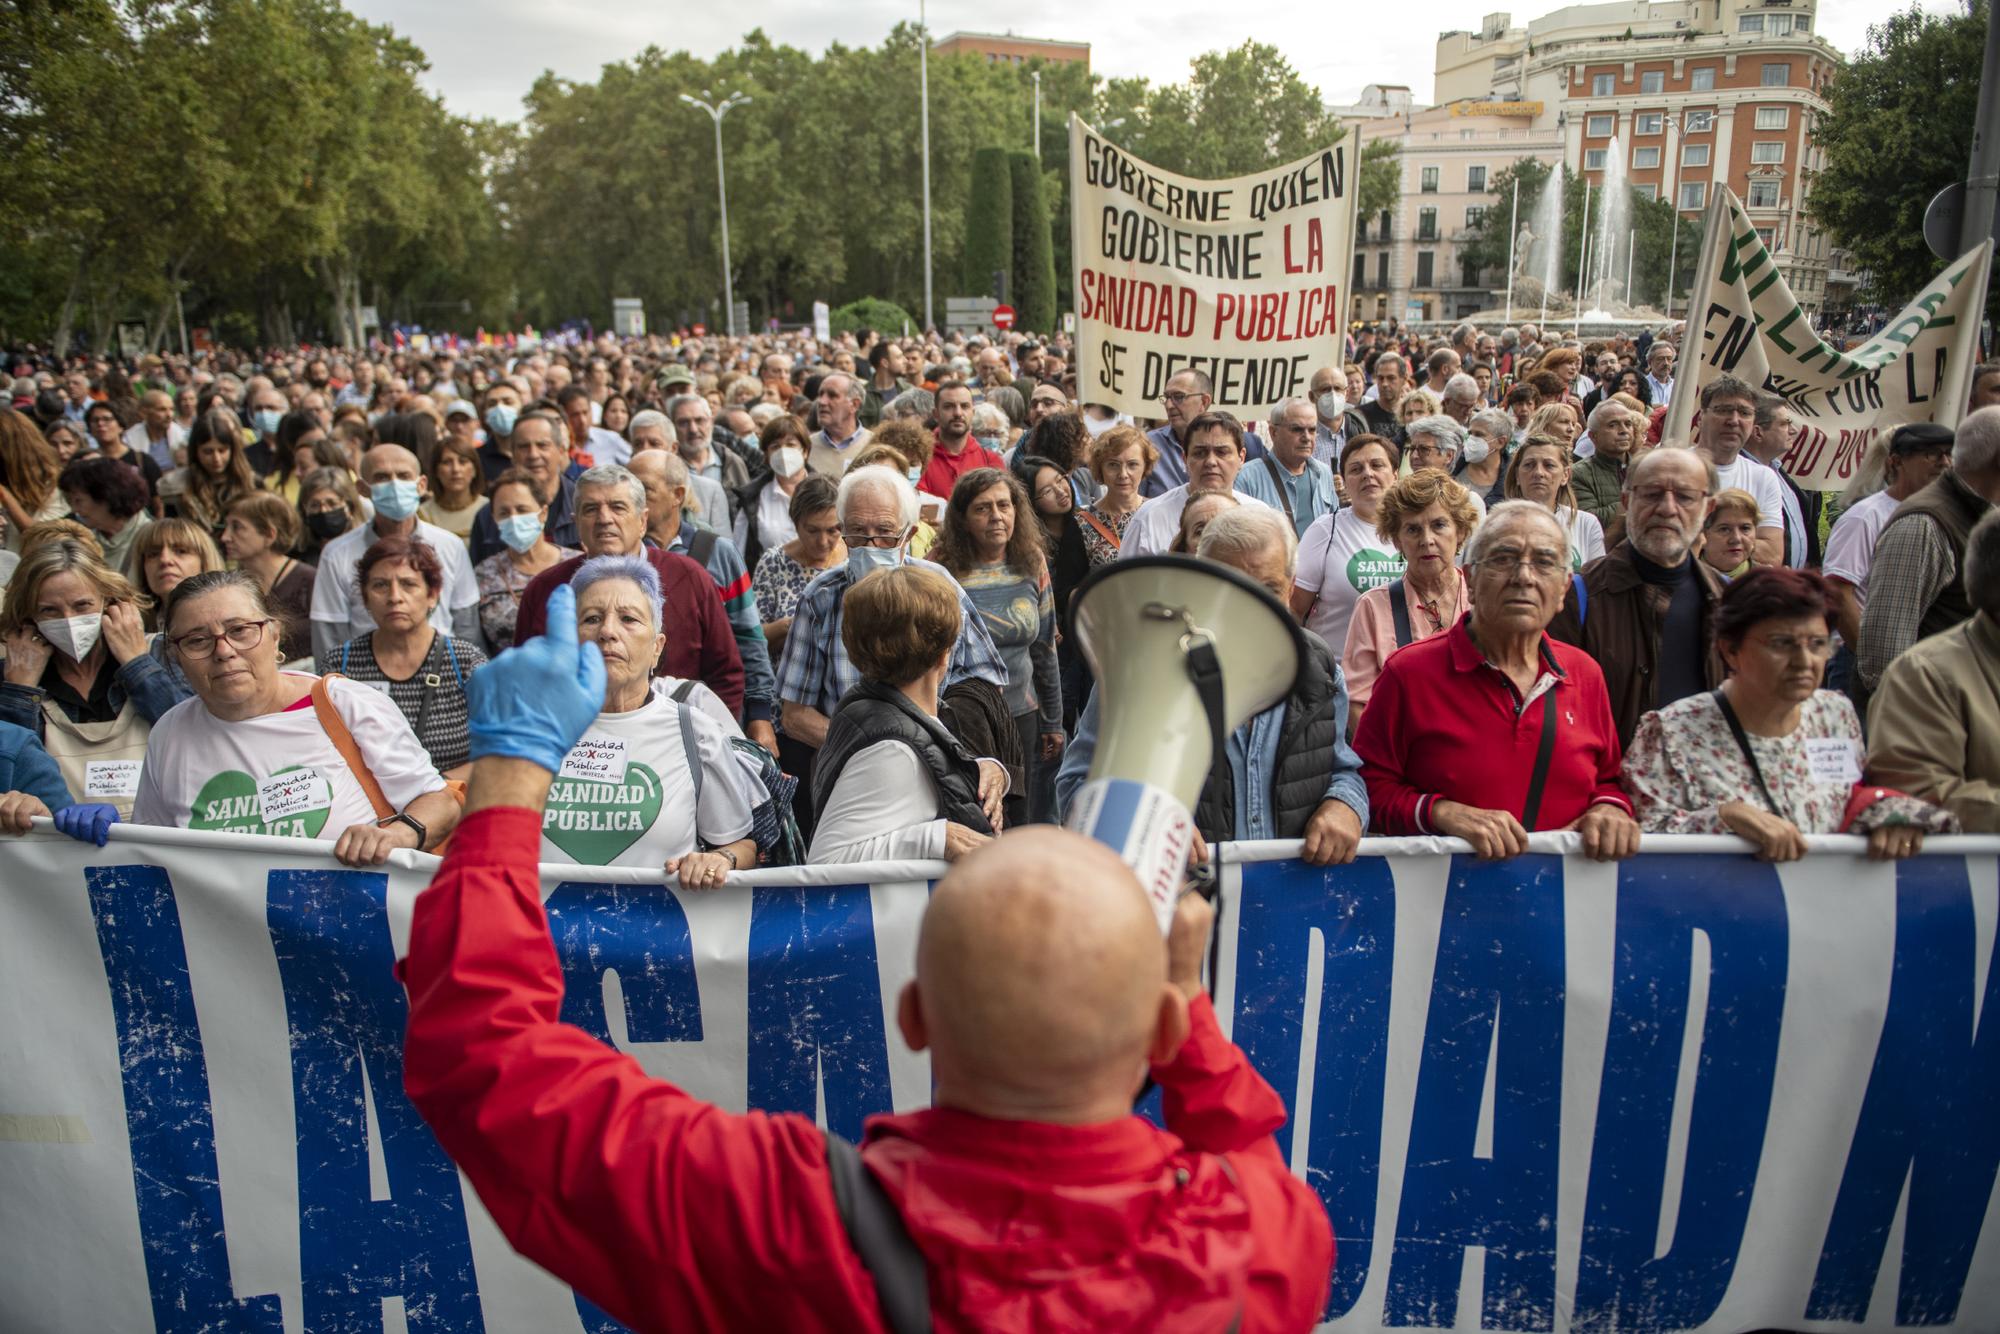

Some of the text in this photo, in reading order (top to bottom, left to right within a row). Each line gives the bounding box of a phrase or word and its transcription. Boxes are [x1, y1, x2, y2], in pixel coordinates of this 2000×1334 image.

[1085, 134, 1344, 222] GOBIERNE QUIEN
[1102, 205, 1324, 280] GOBIERNE LA
[1081, 268, 1336, 342] SANIDAD PUBLICA
[1100, 340, 1127, 395] SE
[566, 758, 609, 771] Pública
[262, 770, 318, 795] Sanidad
[548, 782, 645, 804] SANIDAD
[204, 794, 262, 822] SANI
[265, 794, 309, 814] Pública
[542, 803, 645, 831] PÚBLICA
[84, 864, 486, 1334] LA
